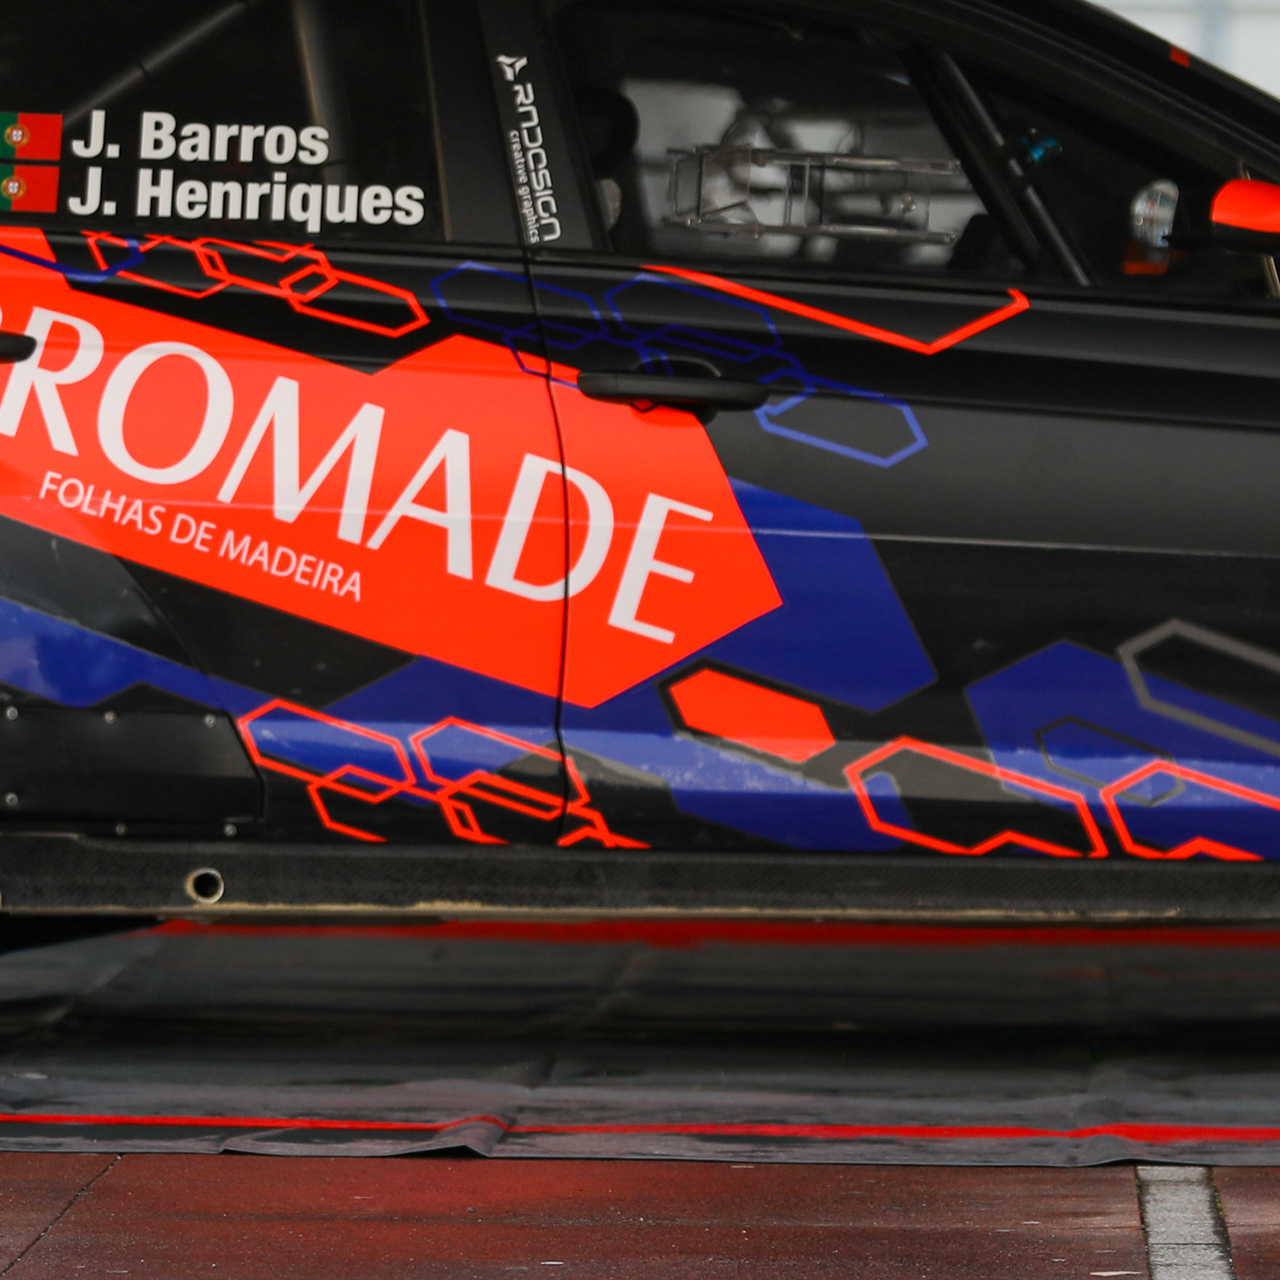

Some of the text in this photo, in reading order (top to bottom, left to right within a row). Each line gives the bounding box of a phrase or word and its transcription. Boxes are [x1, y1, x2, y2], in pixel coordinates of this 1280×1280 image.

[71, 109, 330, 164] J. Barros
[67, 166, 425, 233] J. Henriques
[508, 129, 541, 245] creative graphics
[39, 470, 362, 603] FOLHAS DE MADEIRA
